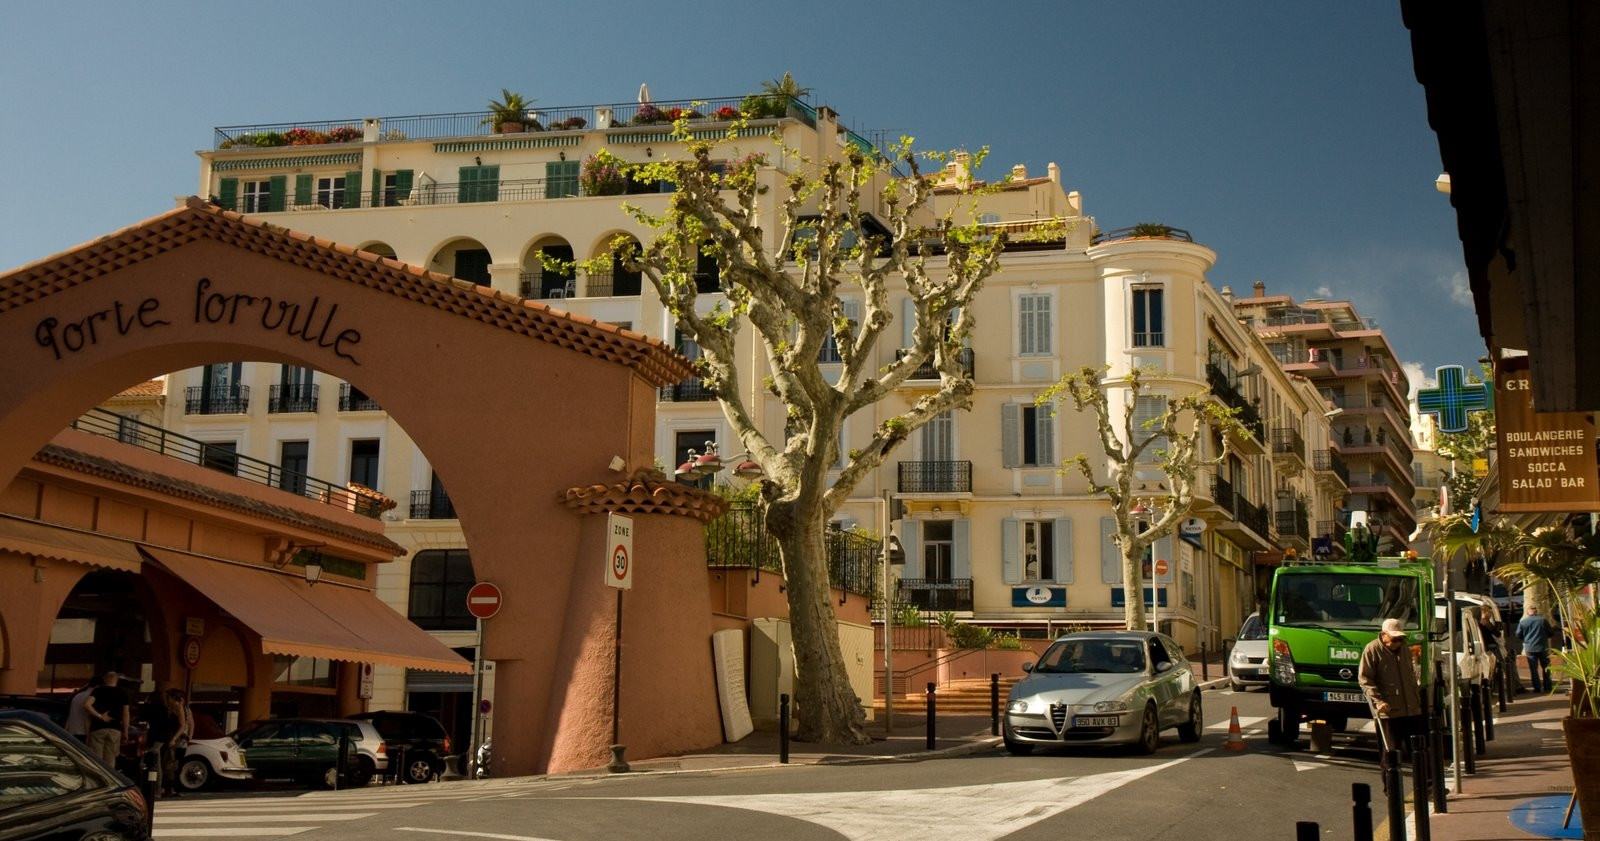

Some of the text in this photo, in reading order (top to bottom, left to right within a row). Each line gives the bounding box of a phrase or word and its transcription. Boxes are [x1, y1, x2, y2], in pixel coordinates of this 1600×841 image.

[34, 296, 171, 361] Porte
[1506, 429, 1584, 442] BOULANGERIE
[1509, 446, 1584, 458] SANDWICHES
[1527, 462, 1566, 473] SOCCA
[614, 525, 630, 537] ZONE
[616, 555, 626, 570] 30
[1330, 647, 1359, 660] Laho
[1092, 718, 1105, 726] AVX
